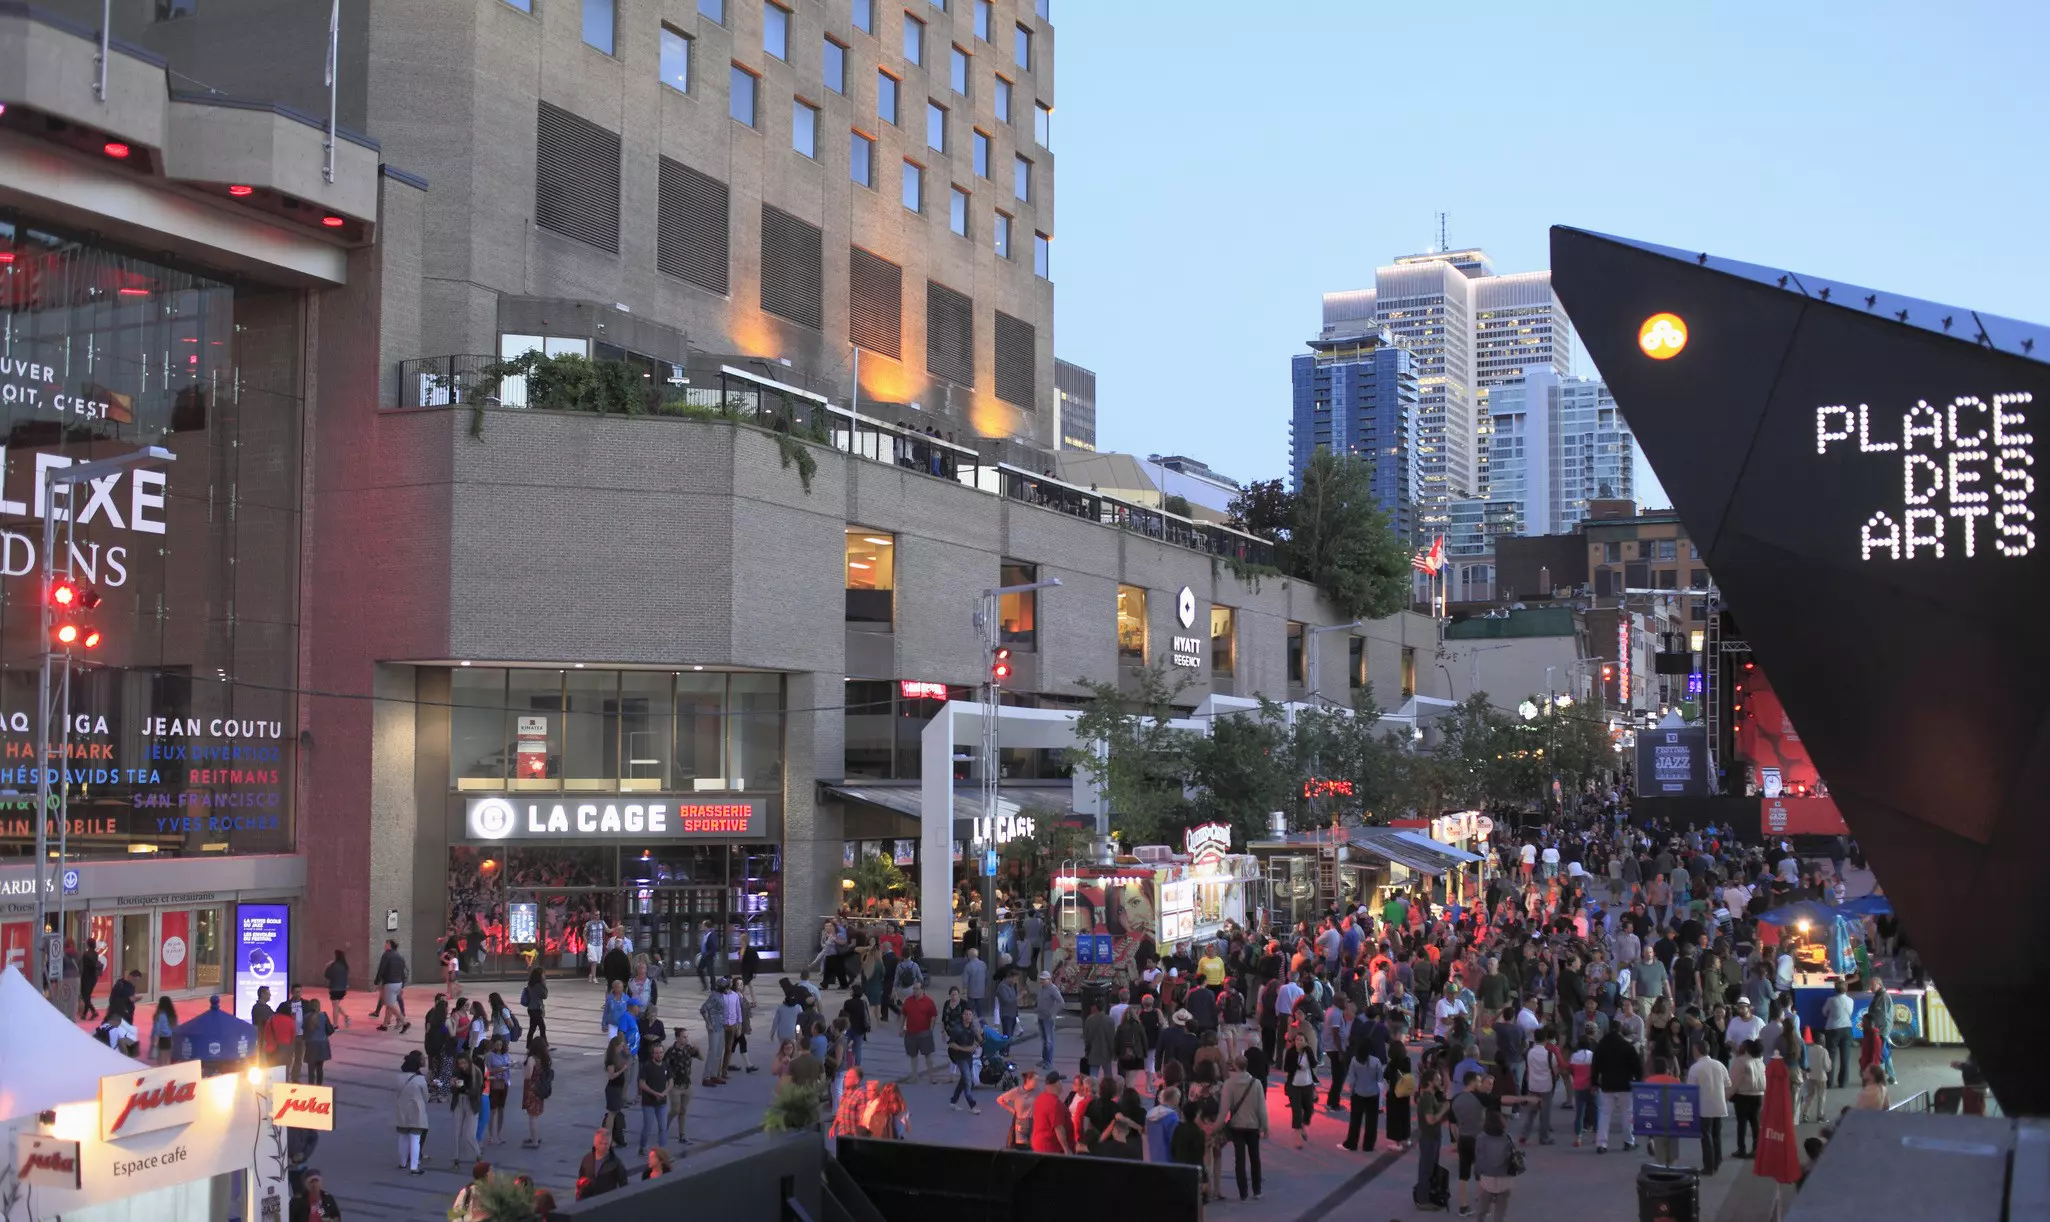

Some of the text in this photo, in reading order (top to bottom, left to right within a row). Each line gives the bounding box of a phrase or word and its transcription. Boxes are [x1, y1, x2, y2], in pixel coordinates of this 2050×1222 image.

[0, 357, 54, 383] UVER
[54, 395, 109, 419] C'EST
[1817, 392, 2033, 455] PLACE
[1904, 448, 2034, 505] DES
[1861, 503, 2035, 561] ARTS
[0, 530, 127, 587] DNS
[1173, 635, 1201, 654] HYATT
[1173, 654, 1201, 668] REGENCY
[66, 714, 109, 734] IGA
[141, 717, 282, 739] JEAN COUTU
[6, 742, 114, 760] HALMARK
[144, 745, 187, 761] JEUX
[1656, 756, 1691, 769] JAZZ
[47, 768, 160, 785] DAVIDS TEA
[190, 769, 279, 784] REITMANS
[134, 792, 280, 808] SAN FRANCISCO
[528, 805, 667, 832] LA CAGE
[680, 805, 752, 817] BRASSERIE
[157, 816, 279, 832] YVES ROCHER
[684, 819, 748, 831] SPORTIVE
[973, 816, 993, 844] LA
[0, 879, 54, 895] ARDIS
[117, 896, 159, 907] Boutiques
[171, 892, 215, 902] restaurants
[110, 1077, 196, 1134] jura
[274, 1088, 331, 1120] jura
[18, 1141, 74, 1178] jura
[113, 1146, 187, 1176] Espace café
